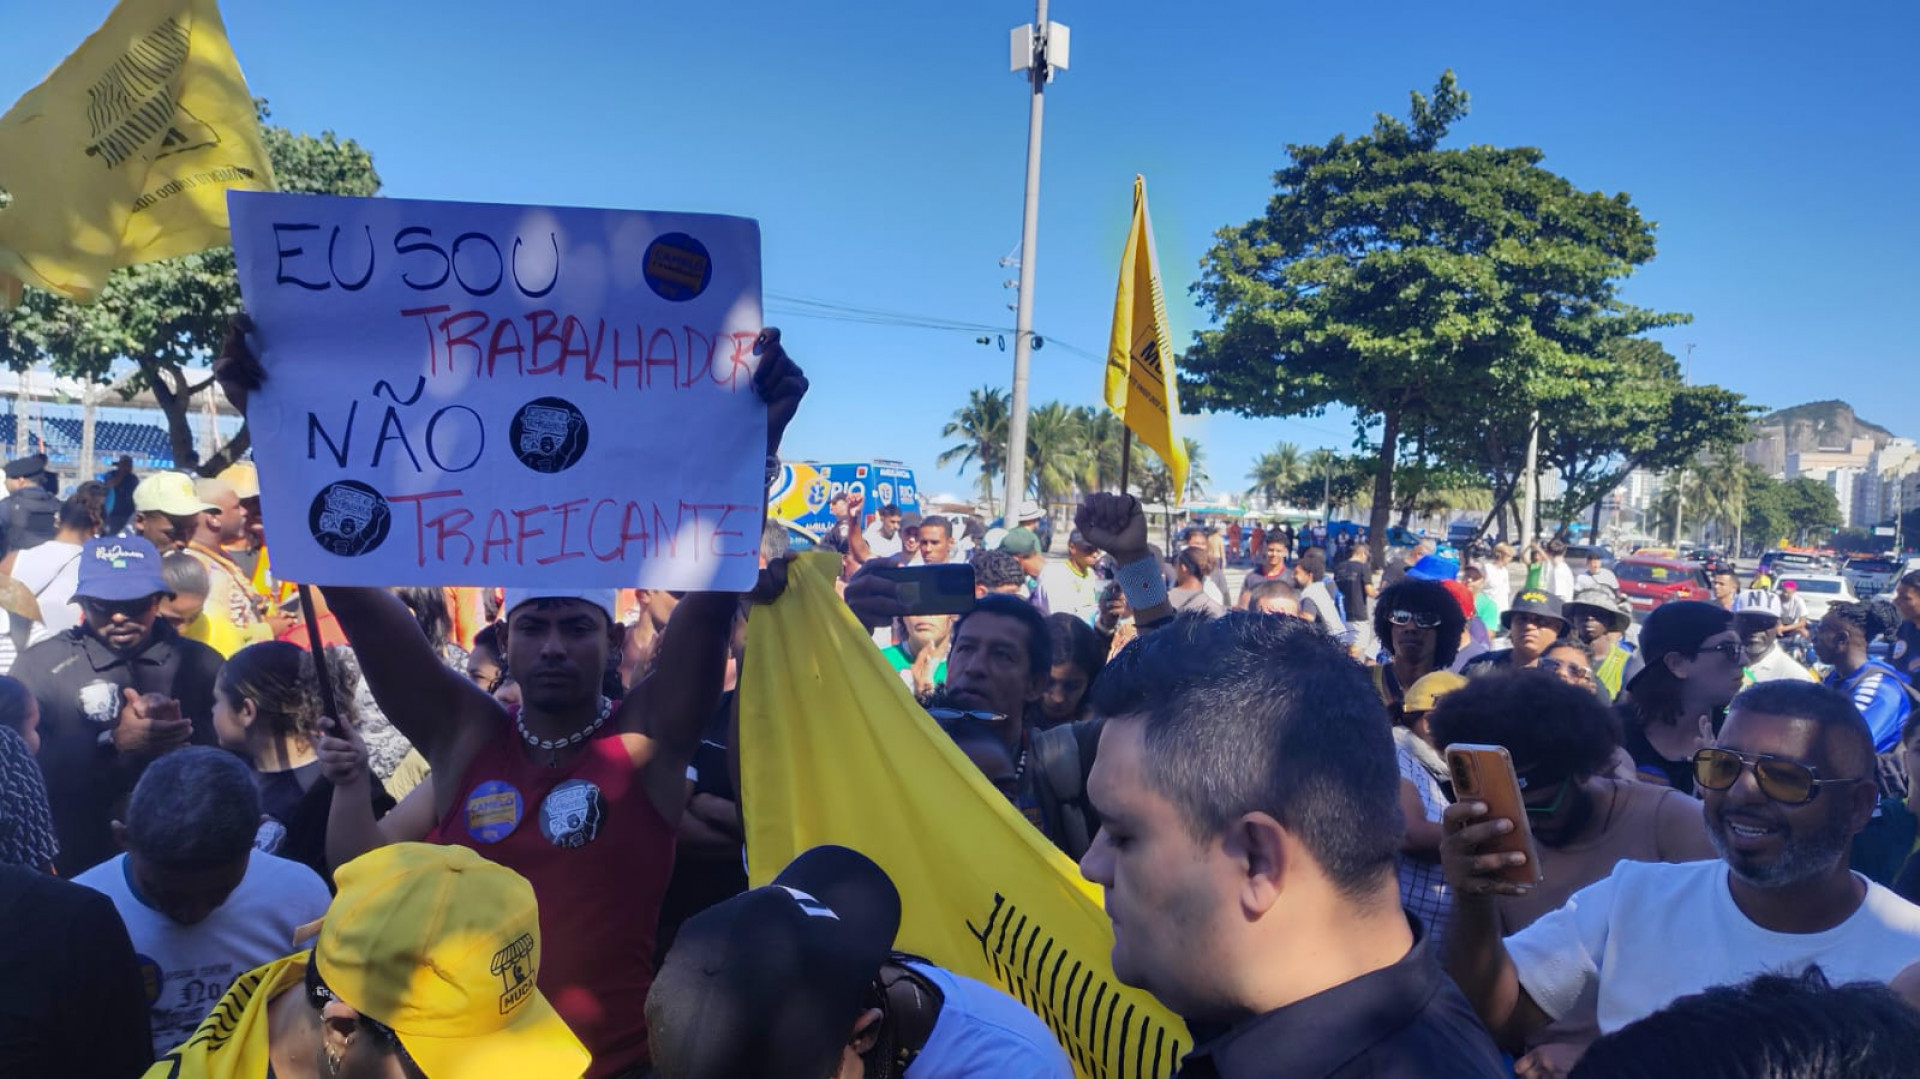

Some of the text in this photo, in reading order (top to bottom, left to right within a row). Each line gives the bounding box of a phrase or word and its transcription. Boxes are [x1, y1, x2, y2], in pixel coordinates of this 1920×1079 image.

[273, 223, 559, 298] EU SOU
[402, 304, 758, 391] TRABALHADOR
[308, 376, 486, 473] NÃO
[386, 489, 757, 567] TRAFICANTE.
